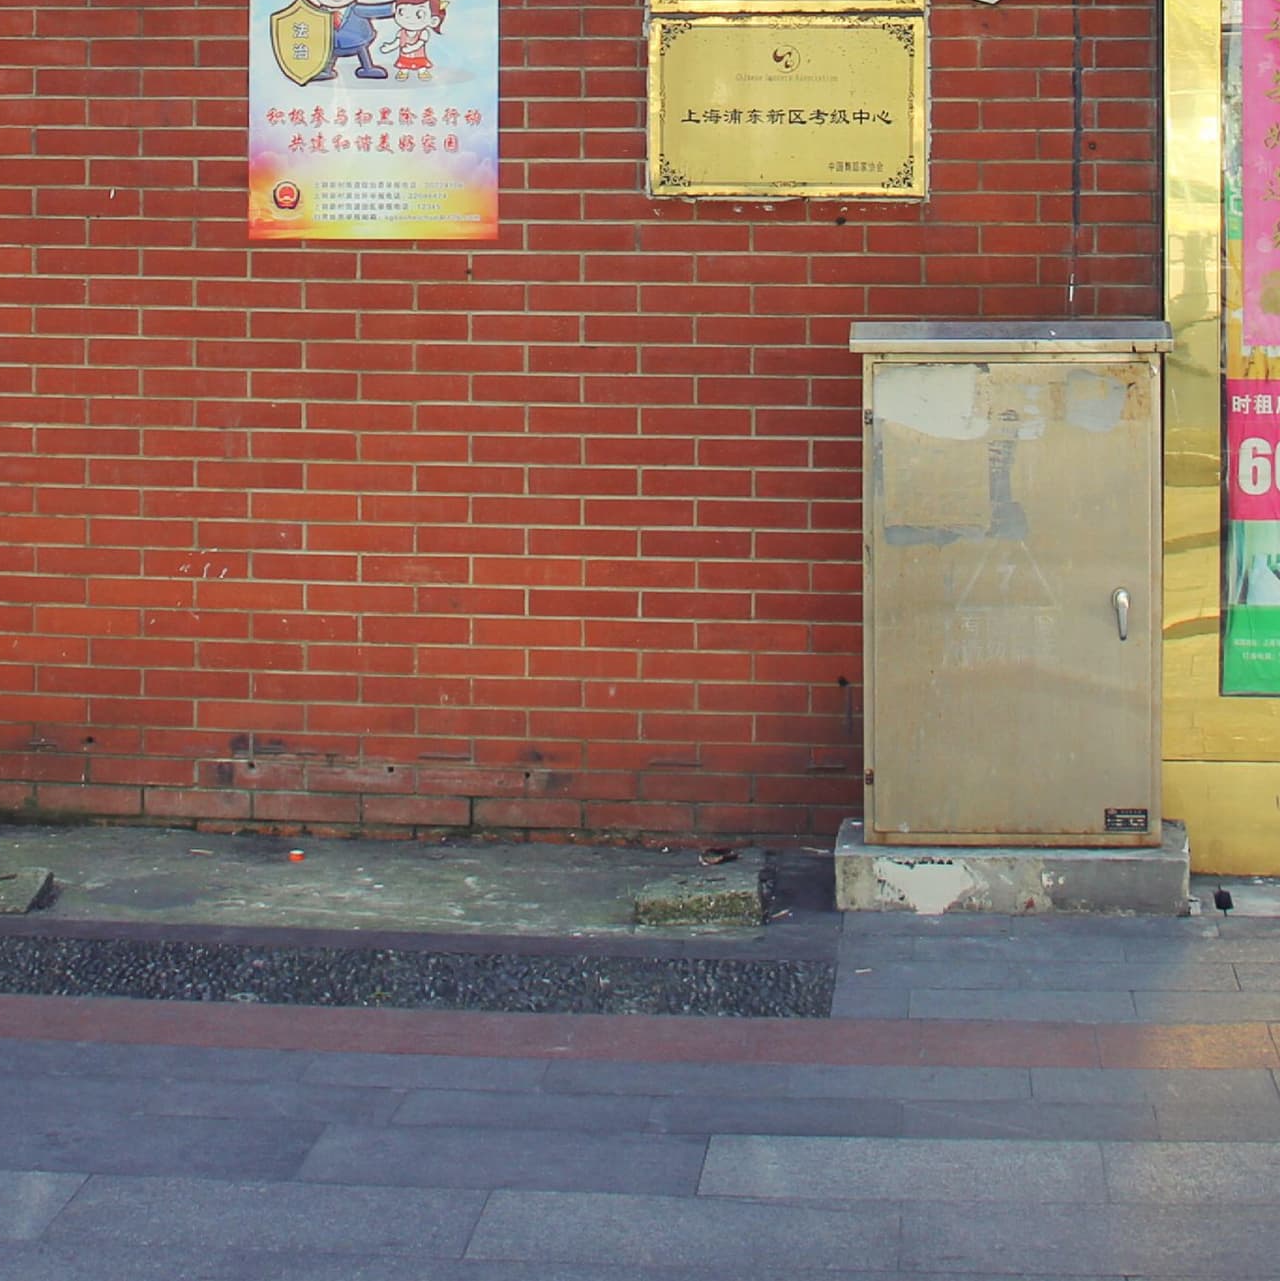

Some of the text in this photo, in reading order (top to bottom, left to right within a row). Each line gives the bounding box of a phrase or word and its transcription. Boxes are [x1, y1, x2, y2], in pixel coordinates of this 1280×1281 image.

[266, 106, 483, 129] 积极参与扫黑除恶行动
[681, 109, 893, 126] 上海浦东新区考级中心
[288, 131, 460, 154] 共建和谐美好家园
